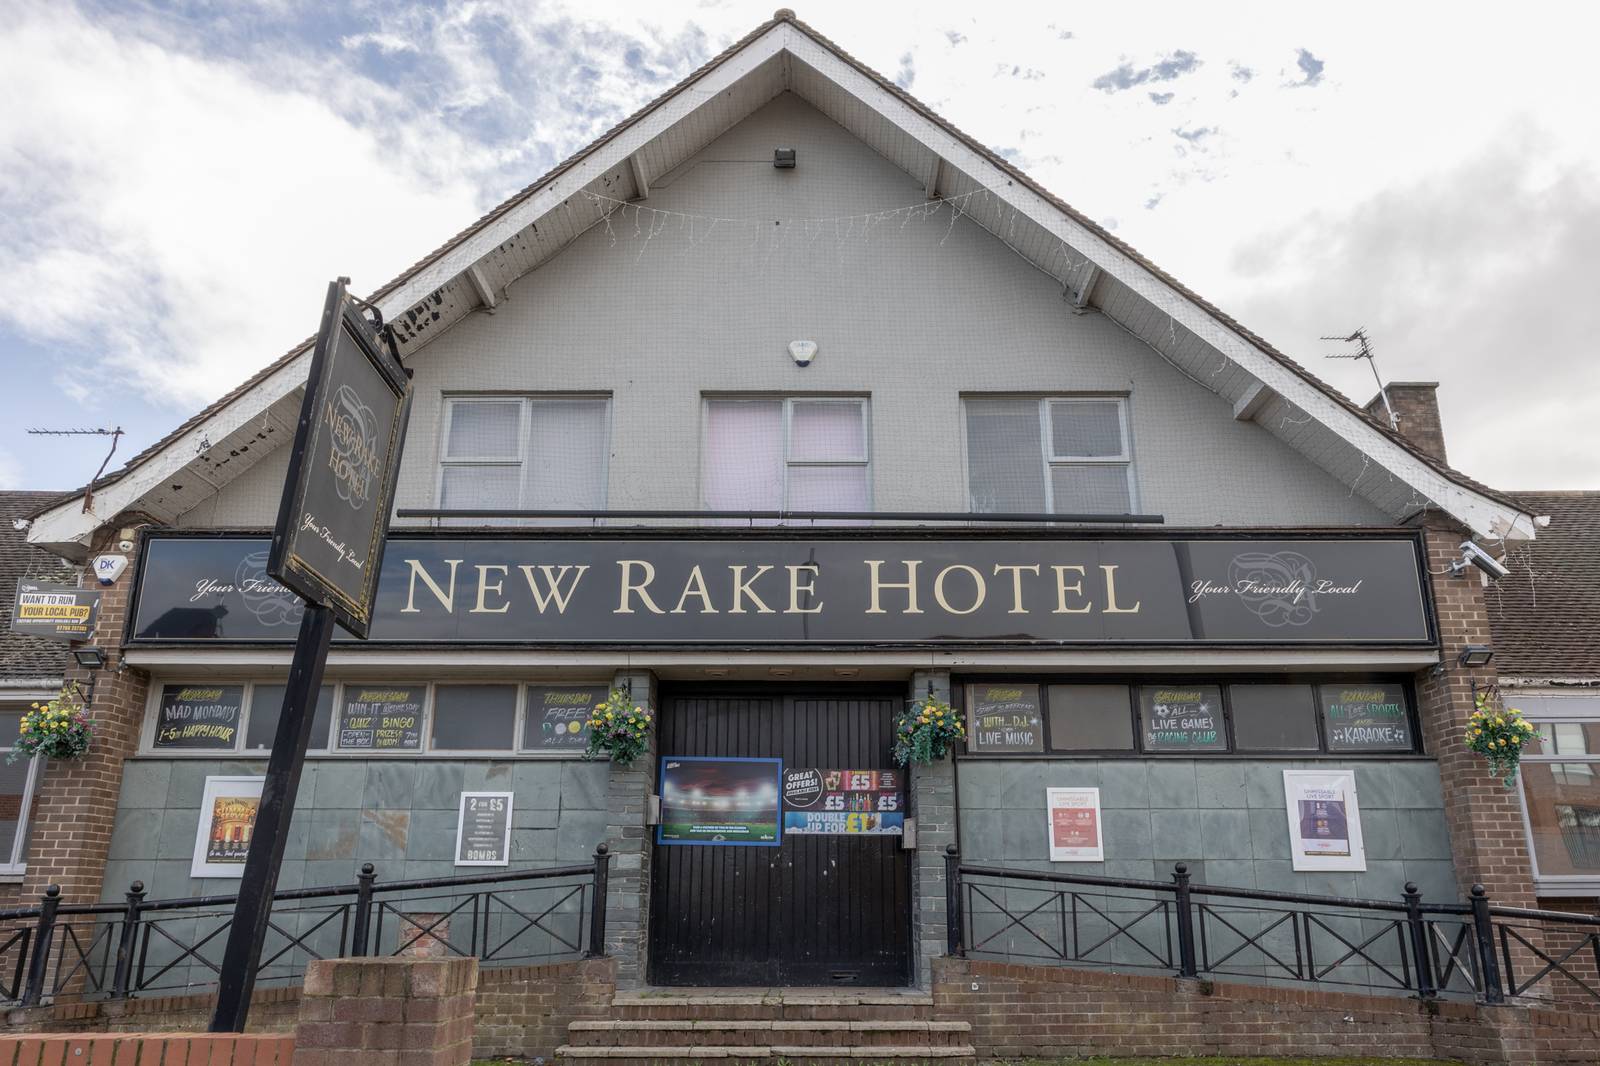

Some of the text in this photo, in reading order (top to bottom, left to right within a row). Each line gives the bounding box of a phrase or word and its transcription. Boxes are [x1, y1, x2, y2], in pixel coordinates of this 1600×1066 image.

[300, 512, 364, 568] Your Friendly Local
[100, 560, 114, 569] DK
[190, 578, 234, 602] Your
[400, 559, 1140, 614] NEW RAKE HOTEL
[1189, 579, 1363, 604] Your Friendly Local
[22, 594, 74, 605] WANT TO RUN
[23, 606, 89, 618] YOUR LOCAL PUB?
[165, 704, 239, 722] MAD MONDAYS
[382, 716, 415, 729] BINGO
[1152, 717, 1215, 730] LIVE GAMES
[182, 724, 210, 738] HAPPY
[208, 725, 234, 742] HOUR
[979, 732, 1034, 746] LIVE MUSIC
[1344, 727, 1395, 744] KARAOKE
[788, 771, 814, 781] GREAT
[851, 774, 870, 790] £5
[785, 779, 818, 790] OFFERS!
[470, 798, 477, 811] 2
[489, 798, 503, 811] £5
[825, 795, 845, 811] £5
[878, 795, 898, 811] £5
[807, 812, 846, 822] DOUBLE
[846, 812, 867, 834] £1
[808, 822, 846, 833] UP FOR
[467, 850, 497, 860] BOMBS
